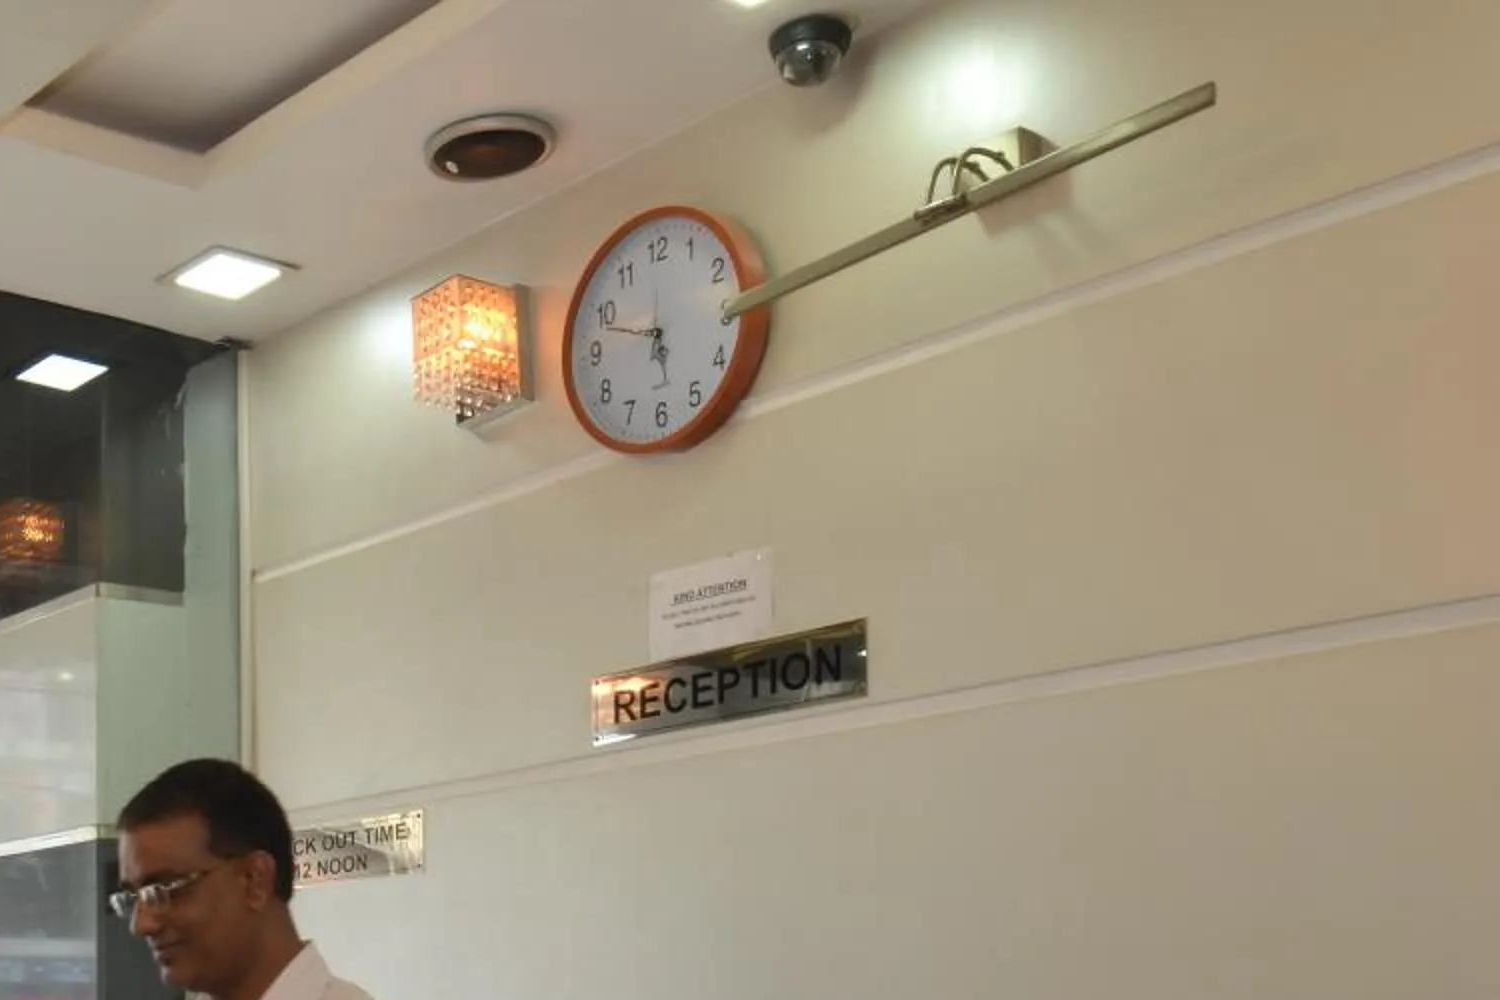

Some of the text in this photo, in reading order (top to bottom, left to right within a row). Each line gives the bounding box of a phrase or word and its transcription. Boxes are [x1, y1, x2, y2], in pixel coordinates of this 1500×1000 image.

[647, 236, 669, 264] 12
[685, 237, 694, 261] 1
[617, 262, 635, 289] 11
[711, 257, 725, 284] 2
[598, 301, 616, 328] 10
[591, 341, 602, 366] 9
[713, 345, 726, 370] 4
[601, 379, 612, 404] 8
[689, 381, 701, 408] 5
[624, 400, 636, 425] 7
[655, 402, 668, 428] 6
[612, 644, 842, 724] RECEPTION
[322, 831, 357, 851] OUT
[364, 822, 409, 845] TIME
[317, 853, 368, 876] NOON
